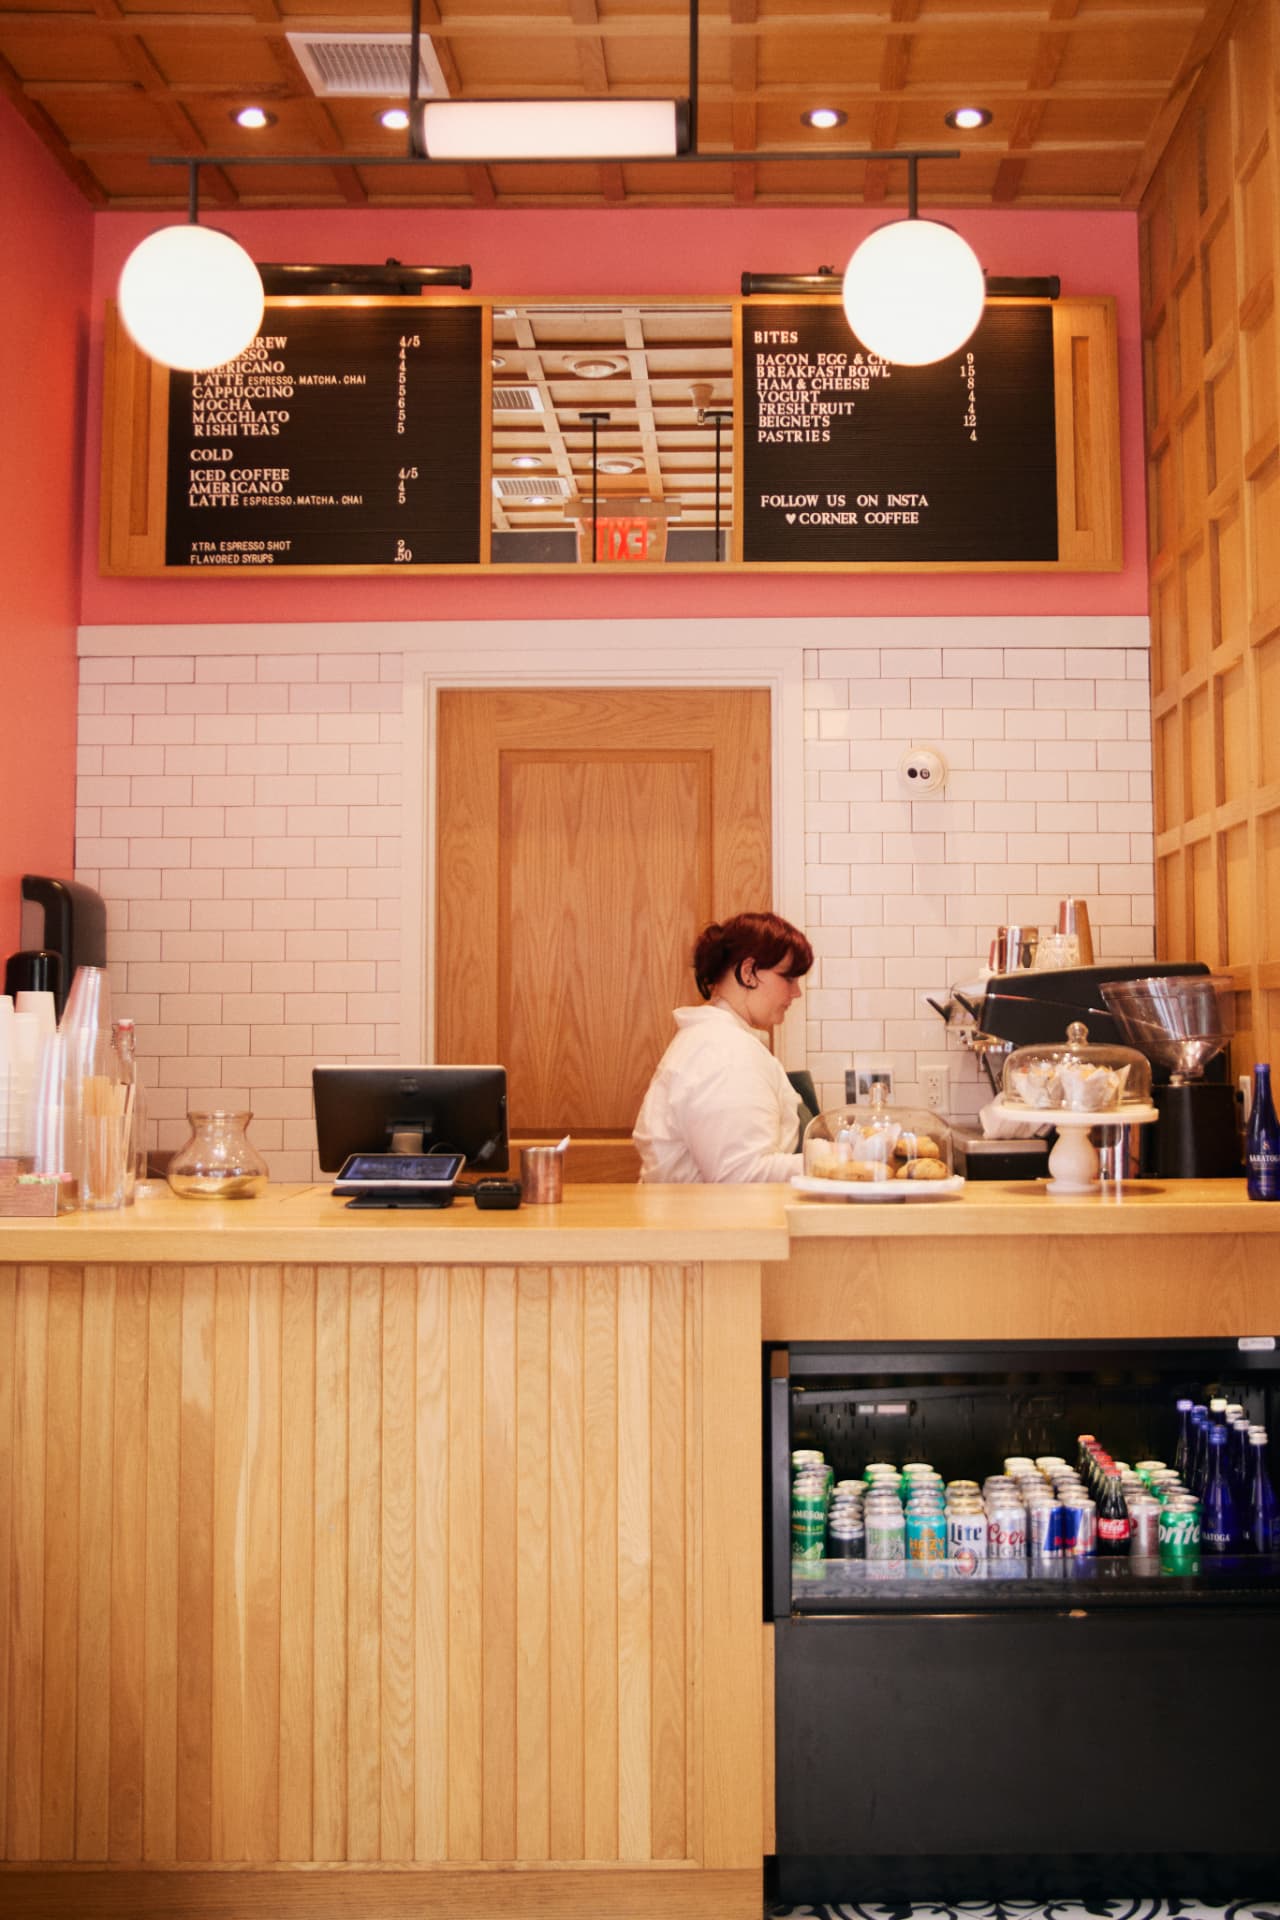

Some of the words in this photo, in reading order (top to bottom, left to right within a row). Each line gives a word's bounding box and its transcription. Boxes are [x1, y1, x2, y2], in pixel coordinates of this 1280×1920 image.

[400, 336, 420, 348] 4/5
[754, 331, 798, 344] BITES
[400, 348, 406, 360] 4
[756, 354, 808, 366] BACON
[818, 354, 847, 364] EGG
[854, 354, 864, 364] &
[966, 352, 974, 364] 9
[400, 360, 406, 372] 4
[756, 366, 846, 378] BREAKFAST
[849, 366, 890, 378] BOWL
[960, 365, 976, 377] 15
[193, 374, 244, 386] LATTE
[400, 373, 406, 384] 5
[757, 378, 792, 390] HAM
[796, 378, 806, 390] &
[811, 378, 870, 390] CHEESE
[967, 377, 975, 389] 8
[192, 386, 294, 398] CAPPUCCINO
[400, 385, 406, 396] 5
[756, 391, 821, 402] YOGURT
[968, 390, 976, 402] 4
[193, 399, 252, 411] MOCHA
[398, 398, 405, 408] 6
[758, 403, 806, 414] FRESH
[810, 402, 855, 414] FRUIT
[968, 402, 976, 414] 4
[192, 411, 290, 423] MACCHIATO
[398, 410, 406, 422] 5
[758, 416, 830, 428] BEIGNETS
[964, 414, 976, 426] 12
[194, 424, 238, 437] RISHI
[241, 424, 280, 436] TEAS
[398, 422, 404, 434] 5
[758, 430, 830, 442] PASTRIES
[970, 429, 978, 441] 4
[190, 448, 234, 461] COLD
[190, 470, 226, 481] ICED
[230, 468, 290, 481] COFFEE
[398, 468, 418, 479] 4/5
[188, 482, 284, 494] AMERICANO
[398, 480, 405, 492] 4
[189, 494, 240, 506] LATTE
[398, 492, 406, 504] 5
[760, 494, 819, 508] FOLLOW
[827, 494, 846, 507] US
[857, 494, 878, 506] ON
[888, 494, 928, 506] INSTA
[798, 512, 858, 525] CORNER
[864, 512, 920, 524] COFFEE
[192, 542, 216, 552] XTRA
[220, 542, 265, 551] ESPRESSO
[267, 541, 292, 550] SHOT
[190, 554, 240, 564] FLAVORED
[242, 554, 274, 563] SYRUPS
[951, 1522, 982, 1546] Lite
